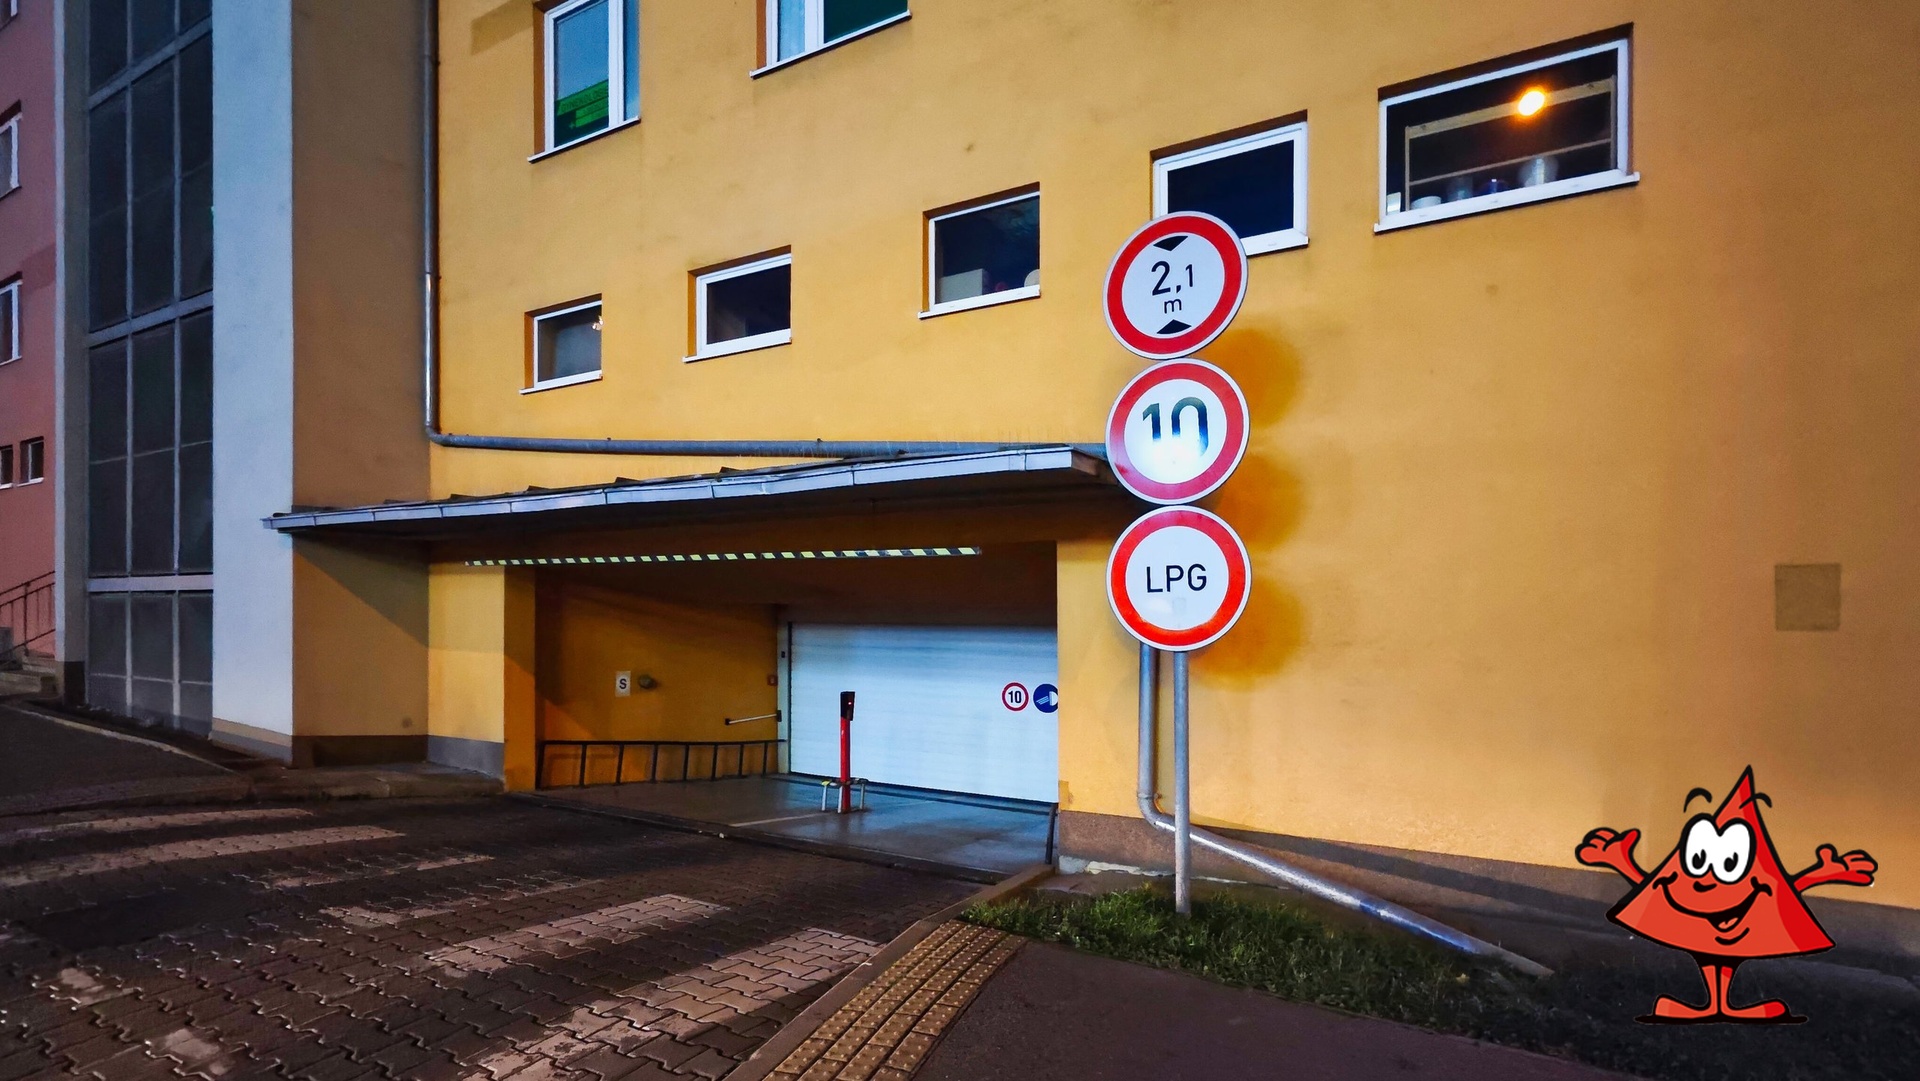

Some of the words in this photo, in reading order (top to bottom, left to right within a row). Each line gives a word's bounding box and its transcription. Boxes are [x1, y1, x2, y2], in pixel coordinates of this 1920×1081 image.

[1151, 260, 1194, 296] 2,1
[1163, 298, 1183, 314] m
[1142, 396, 1209, 456] 10
[1146, 563, 1207, 593] LPG
[619, 678, 627, 690] S
[1008, 690, 1022, 704] 10
